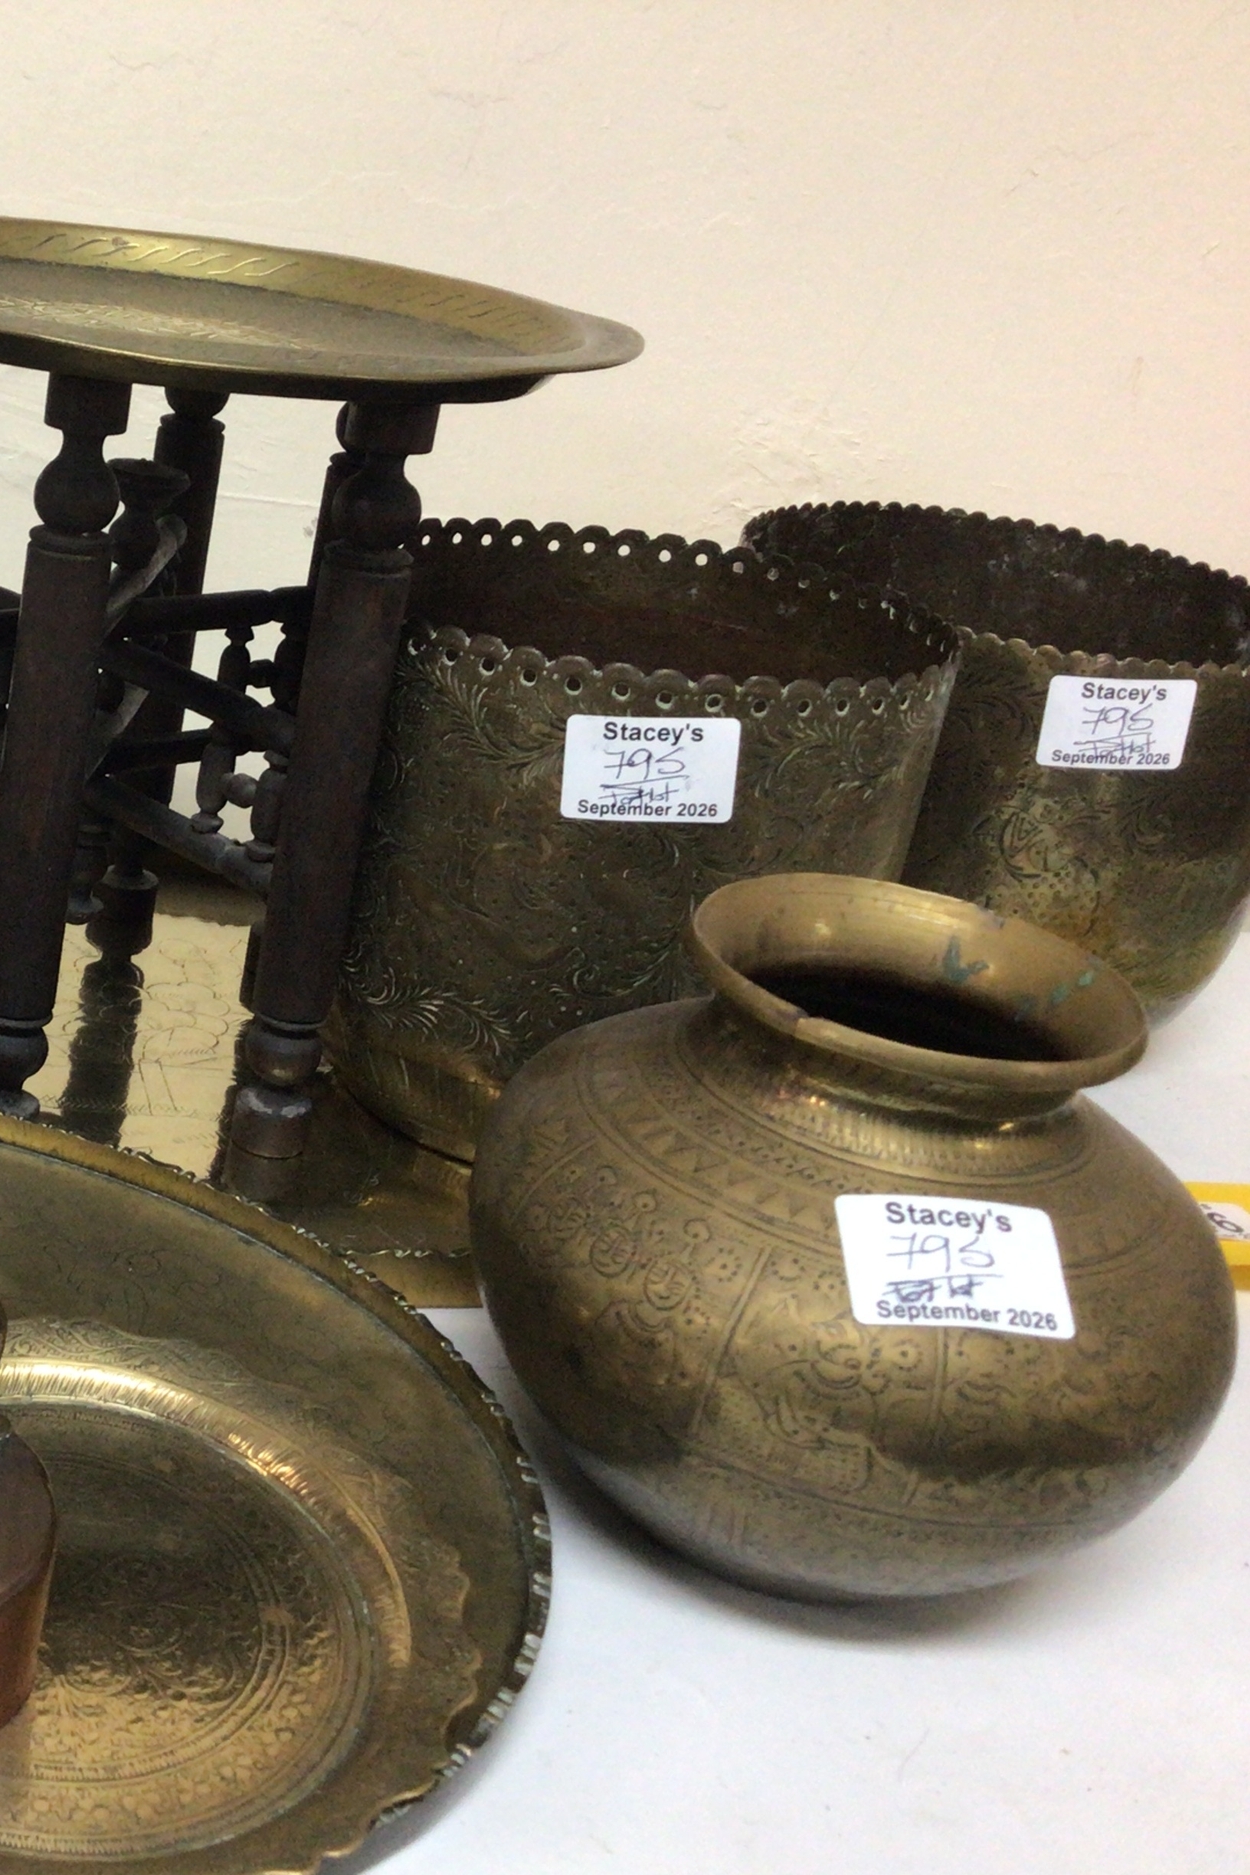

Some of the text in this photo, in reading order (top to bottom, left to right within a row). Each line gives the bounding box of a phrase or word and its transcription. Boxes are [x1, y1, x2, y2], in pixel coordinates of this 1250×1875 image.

[1081, 682, 1167, 705] Stacey's
[603, 721, 704, 746] Stacey's
[603, 747, 685, 779] 795
[1051, 749, 1170, 765] September 2026
[578, 799, 718, 817] September 2026
[885, 1202, 1012, 1234] Stacey's
[876, 1300, 1058, 1331] September 2026
